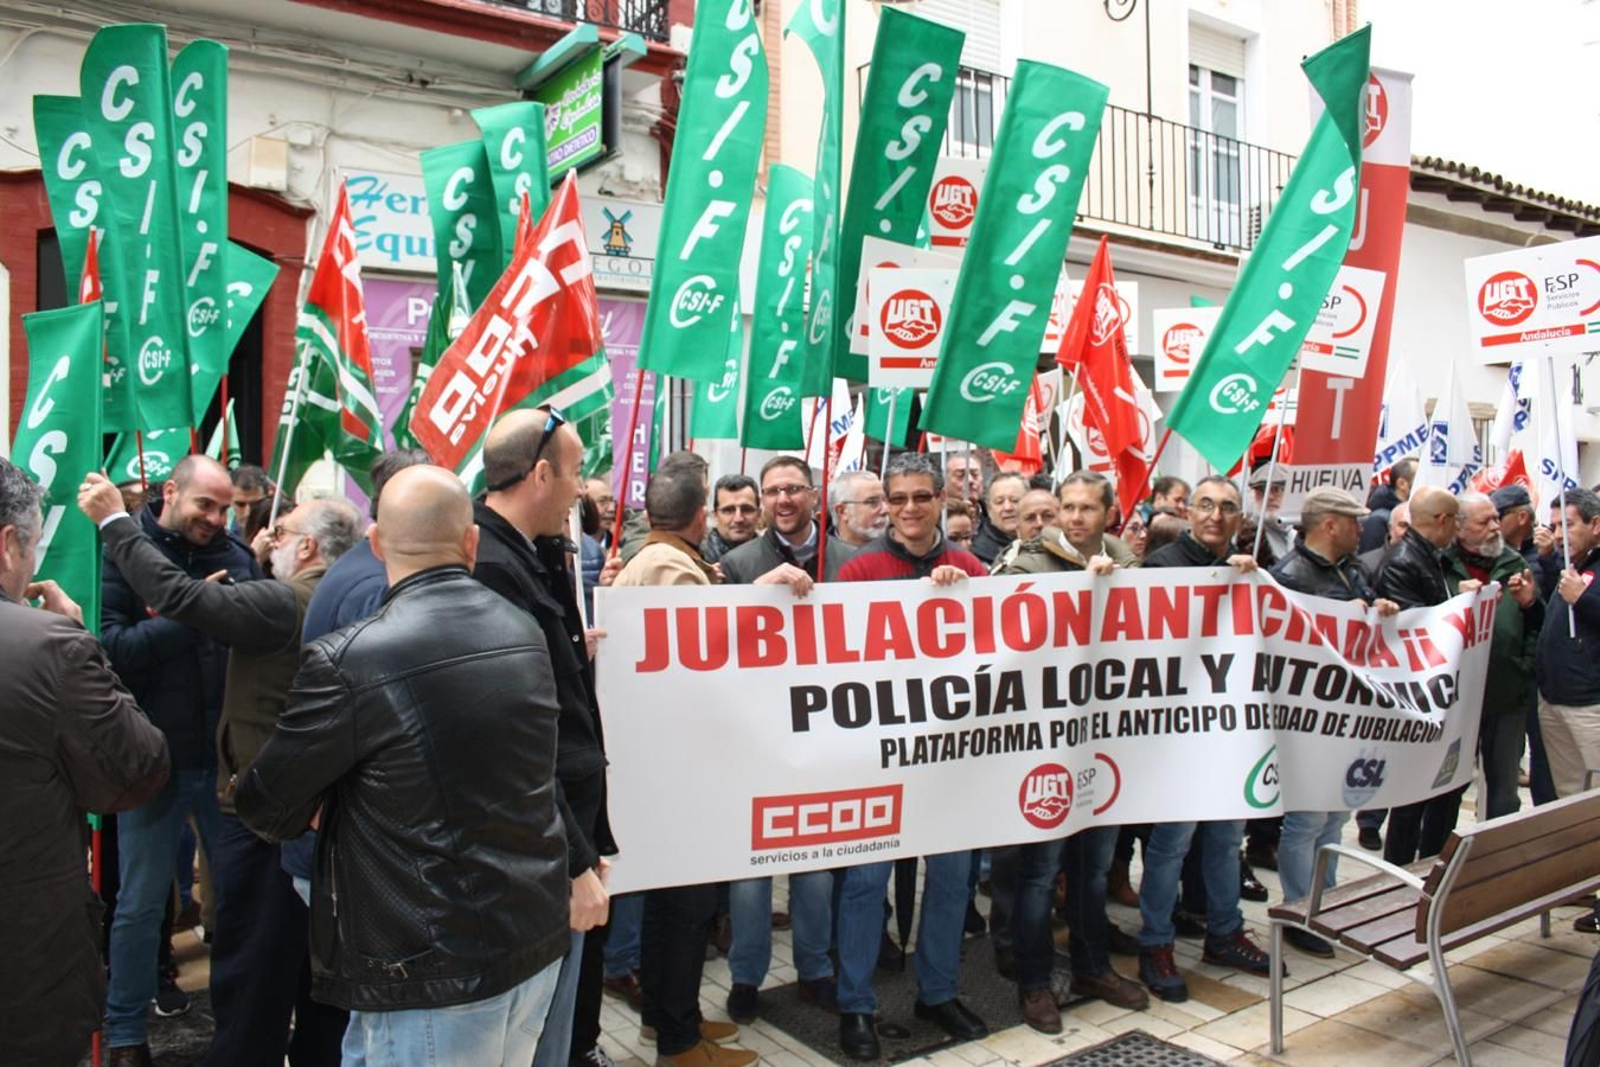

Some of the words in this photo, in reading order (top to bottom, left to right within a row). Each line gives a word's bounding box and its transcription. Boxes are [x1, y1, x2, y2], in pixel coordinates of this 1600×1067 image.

[346, 174, 430, 216] Her
[936, 183, 973, 207] UGT
[1483, 277, 1531, 306] UGT
[886, 297, 936, 326] UGT
[635, 582, 1093, 673] JUBILACIÓN
[789, 664, 1027, 733] POLICÍA
[1041, 656, 1188, 709] LOCAL
[1200, 652, 1235, 694] Y
[880, 721, 1043, 770] PLATAFORMA
[1050, 716, 1089, 749] POR
[1090, 713, 1112, 740] EL
[1117, 703, 1237, 738] ANTICIPO
[1245, 703, 1270, 730] DE
[1273, 703, 1320, 734] EDAD
[1320, 708, 1350, 738] DE
[1025, 771, 1069, 804] UGT
[1345, 757, 1387, 788] CSL
[762, 794, 894, 840] CCOO
[750, 850, 808, 866] servicios
[811, 851, 819, 860] a
[822, 848, 833, 858] la
[836, 838, 901, 857] ciudadanía
